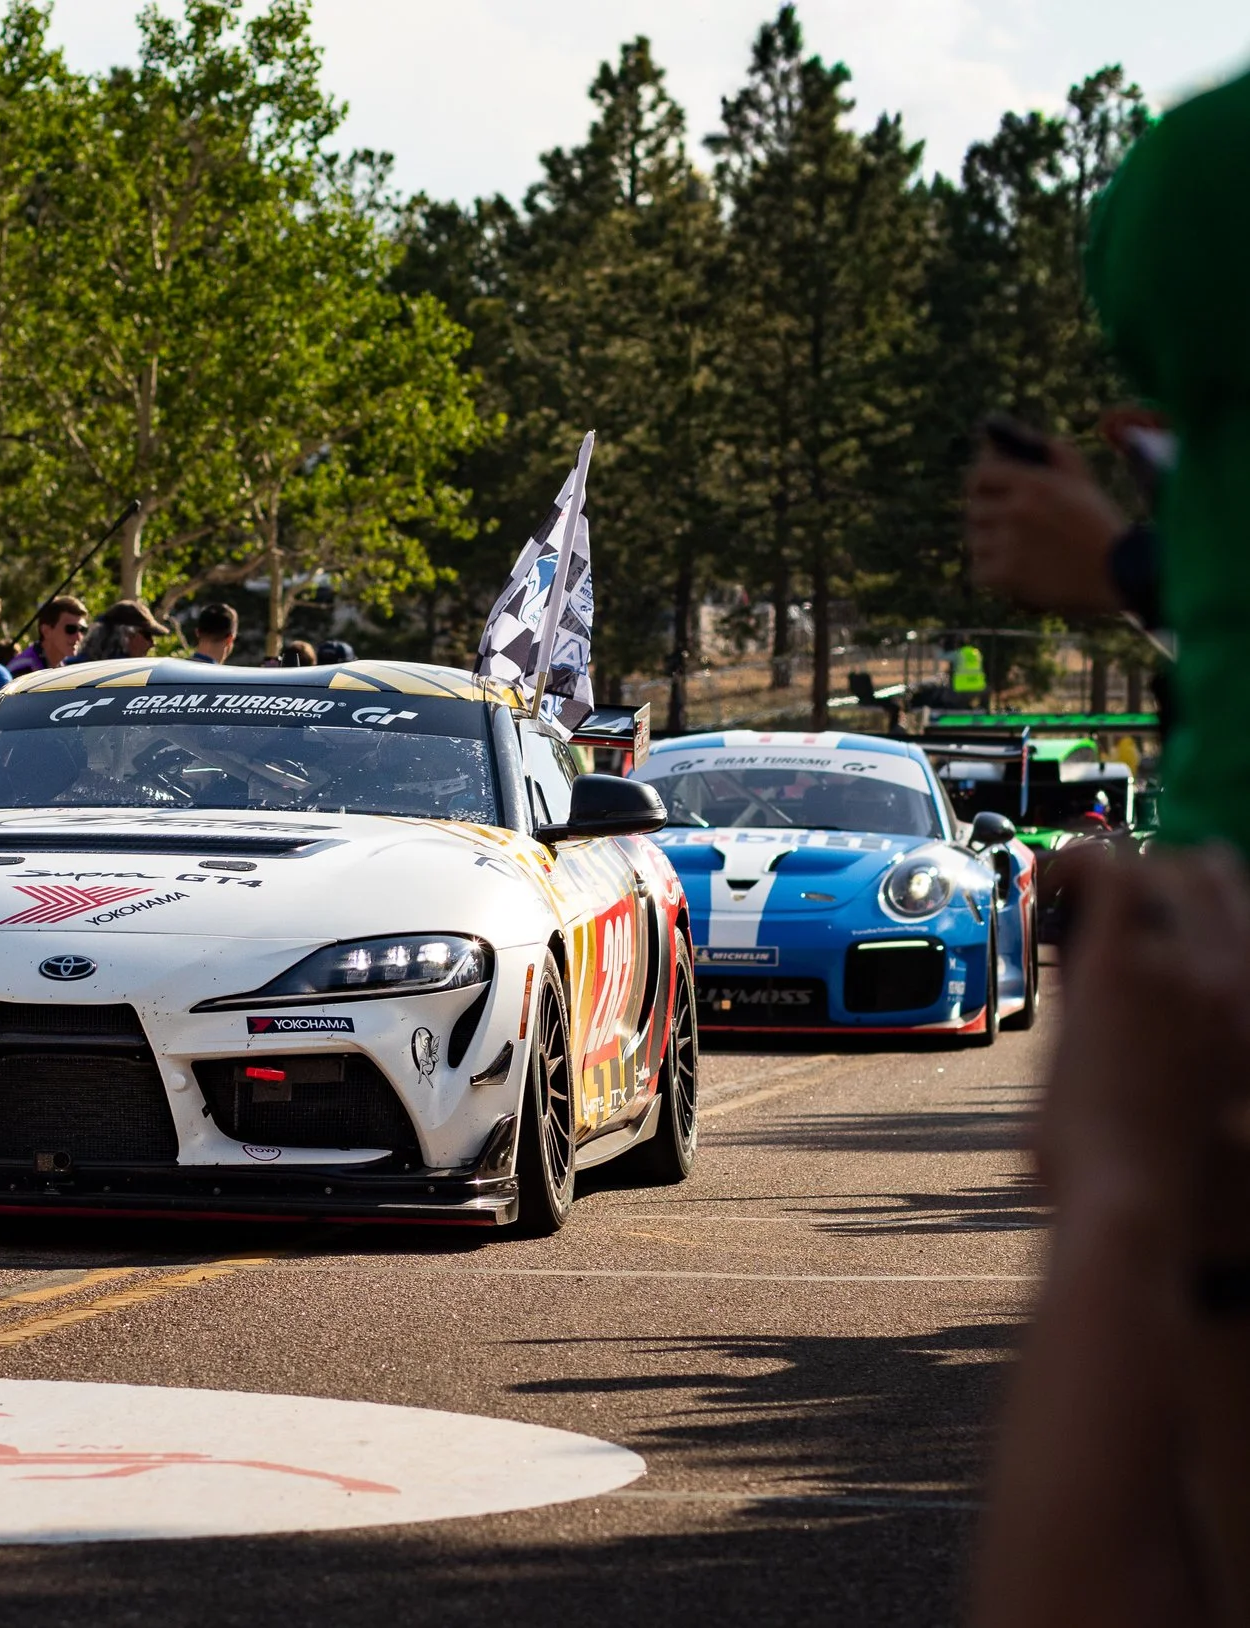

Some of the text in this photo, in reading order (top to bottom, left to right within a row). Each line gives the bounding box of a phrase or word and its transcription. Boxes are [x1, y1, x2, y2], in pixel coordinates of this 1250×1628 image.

[125, 694, 336, 713] GRAN TURISMO
[244, 708, 322, 719] SIMULATOR
[713, 756, 831, 767] GRAN TURISMO
[174, 873, 264, 888] GT4
[85, 891, 190, 926] YOKOHAMA
[712, 951, 770, 961] MICHELIN
[274, 1019, 349, 1029] YOKOHAMA
